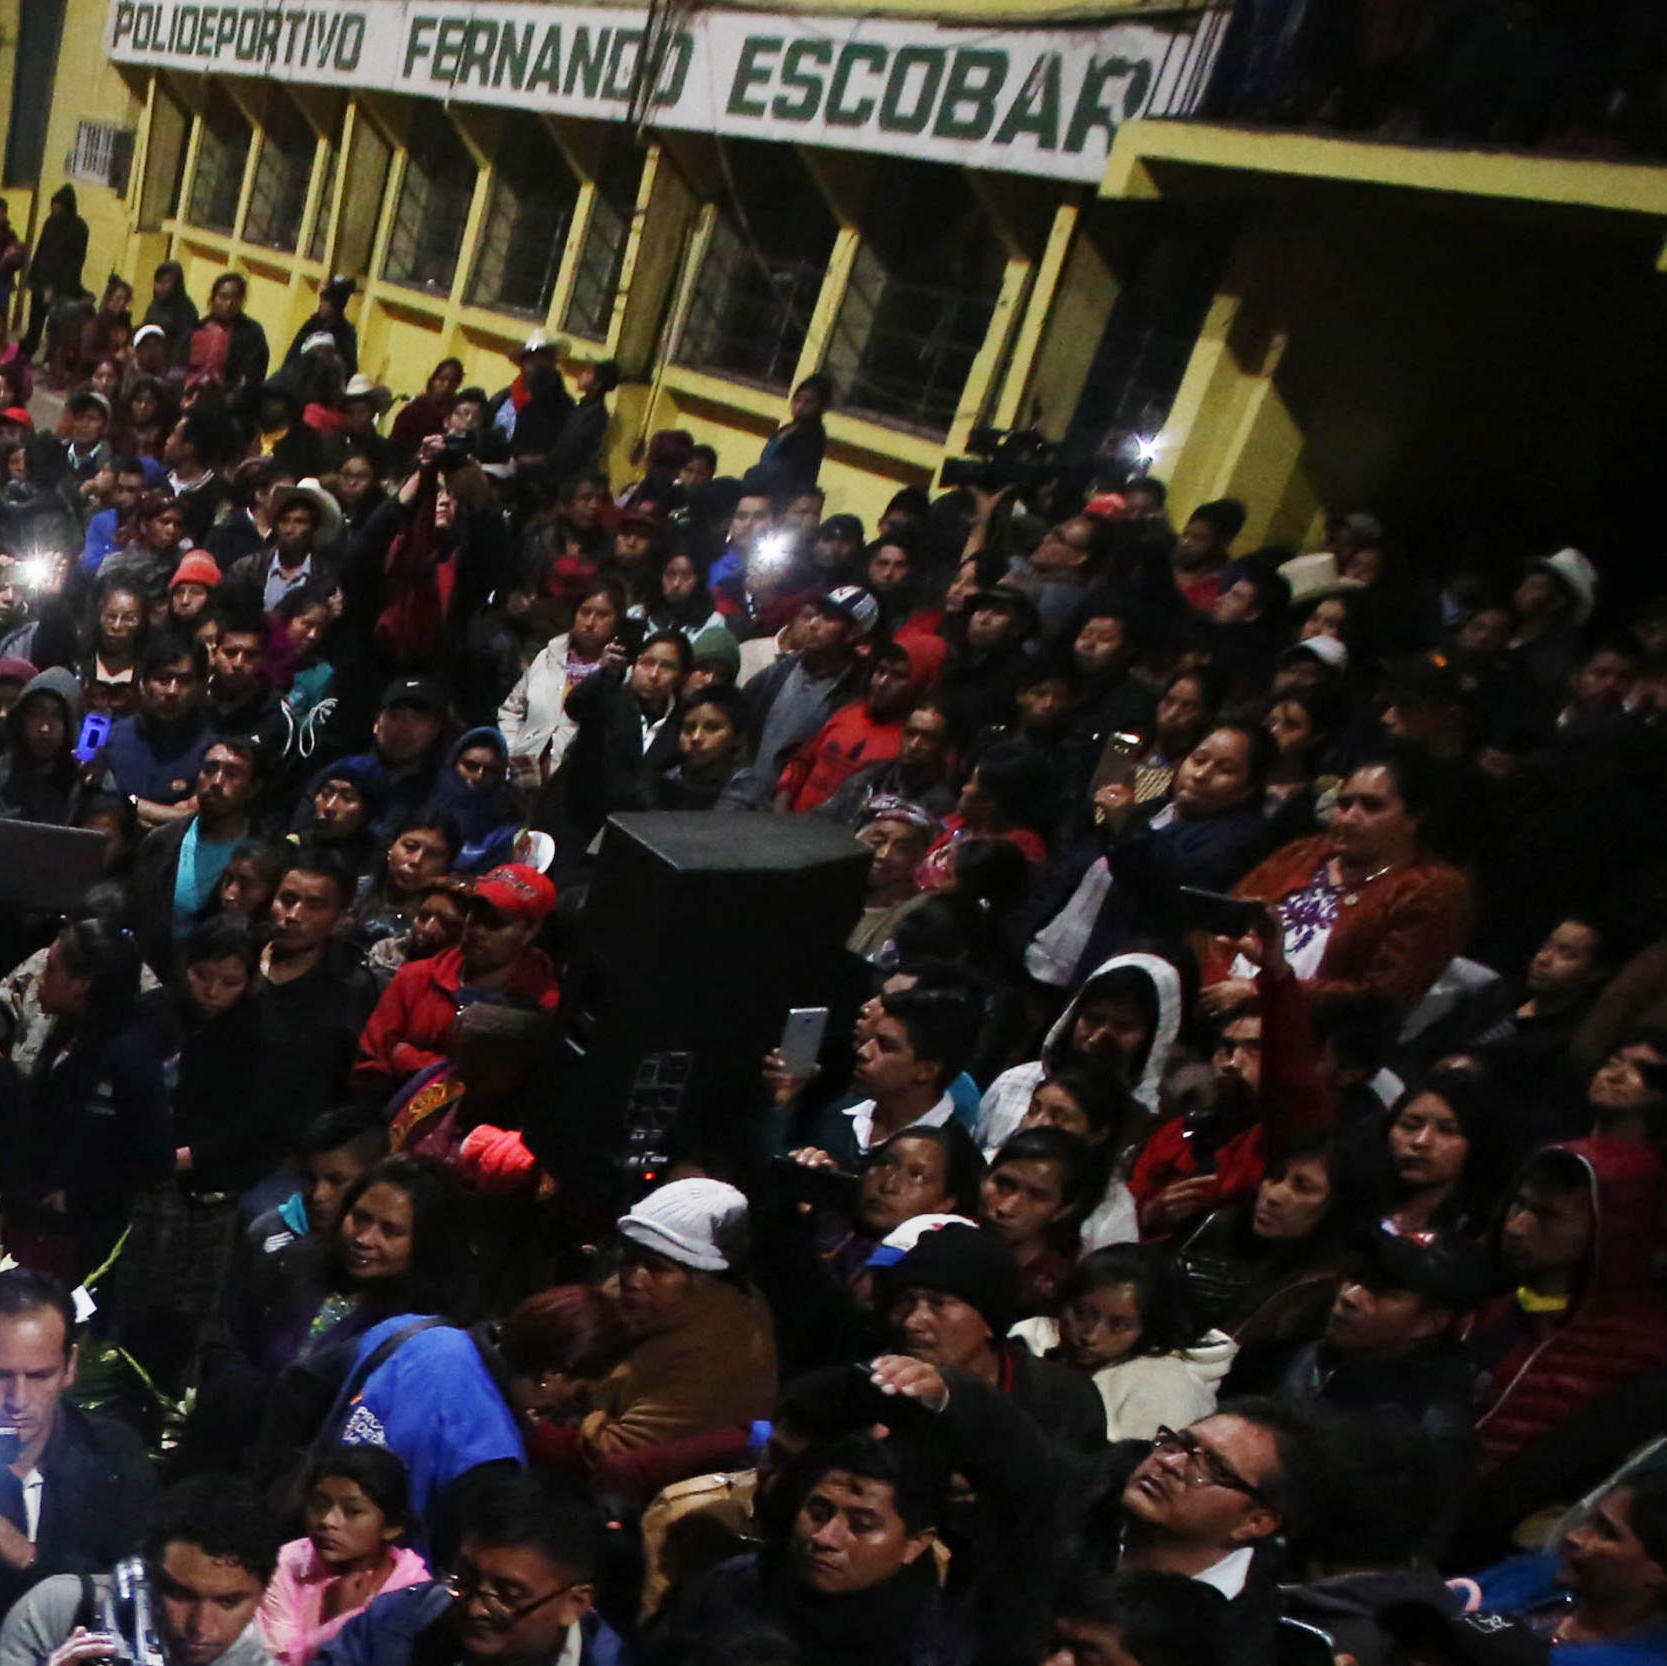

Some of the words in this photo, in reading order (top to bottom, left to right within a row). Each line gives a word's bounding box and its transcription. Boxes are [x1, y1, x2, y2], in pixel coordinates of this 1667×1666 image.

[113, 1, 366, 71] POLIDEPORTIVO
[402, 15, 693, 109] FERNANDO
[725, 35, 1152, 154] ESCOBAR
